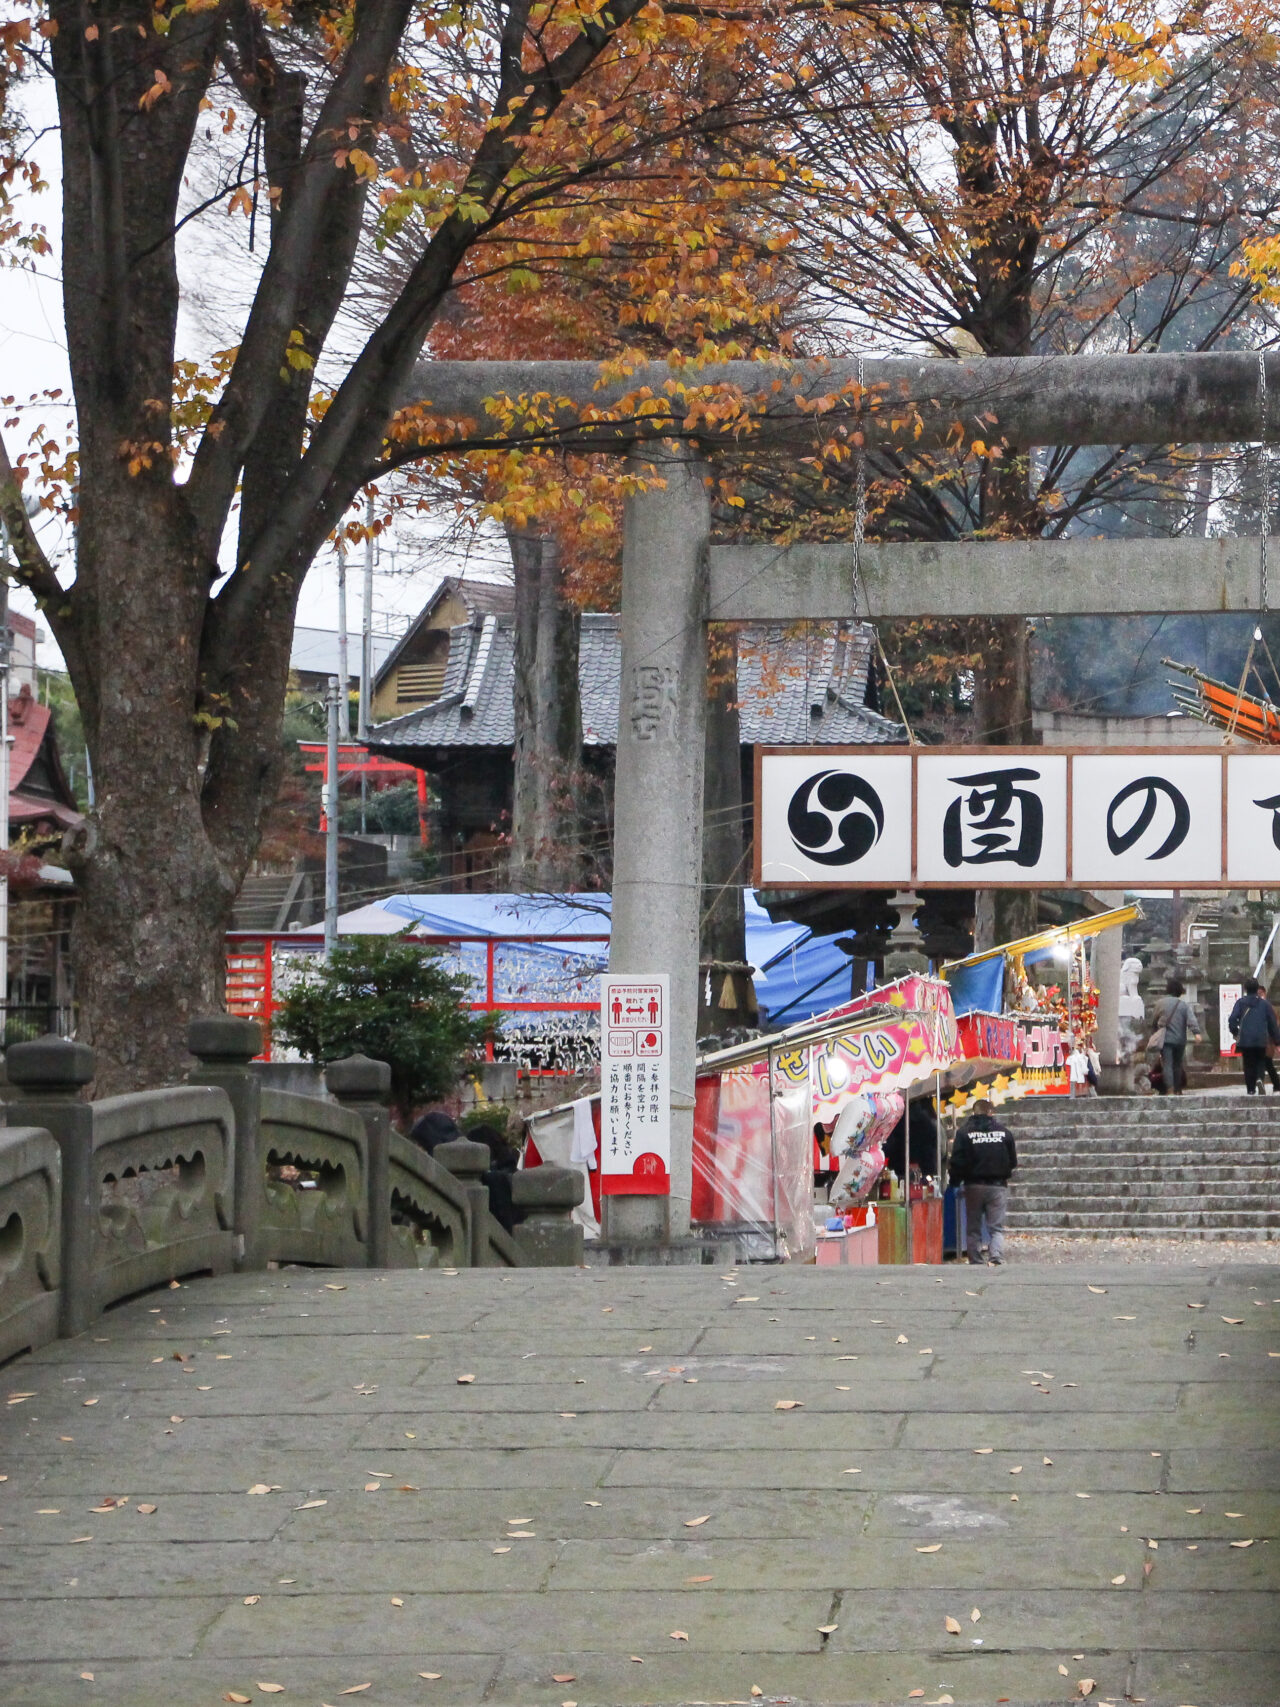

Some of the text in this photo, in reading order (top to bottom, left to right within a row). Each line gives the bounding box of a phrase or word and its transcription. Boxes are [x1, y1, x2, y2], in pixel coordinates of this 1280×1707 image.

[610, 1064, 620, 1156] ご協力お願いします
[623, 1063, 633, 1156] 順番にお参りください
[636, 1062, 646, 1123] 間隔を空けて
[650, 1063, 659, 1123] ご参拝の際は
[967, 1131, 1006, 1139] WINTER
